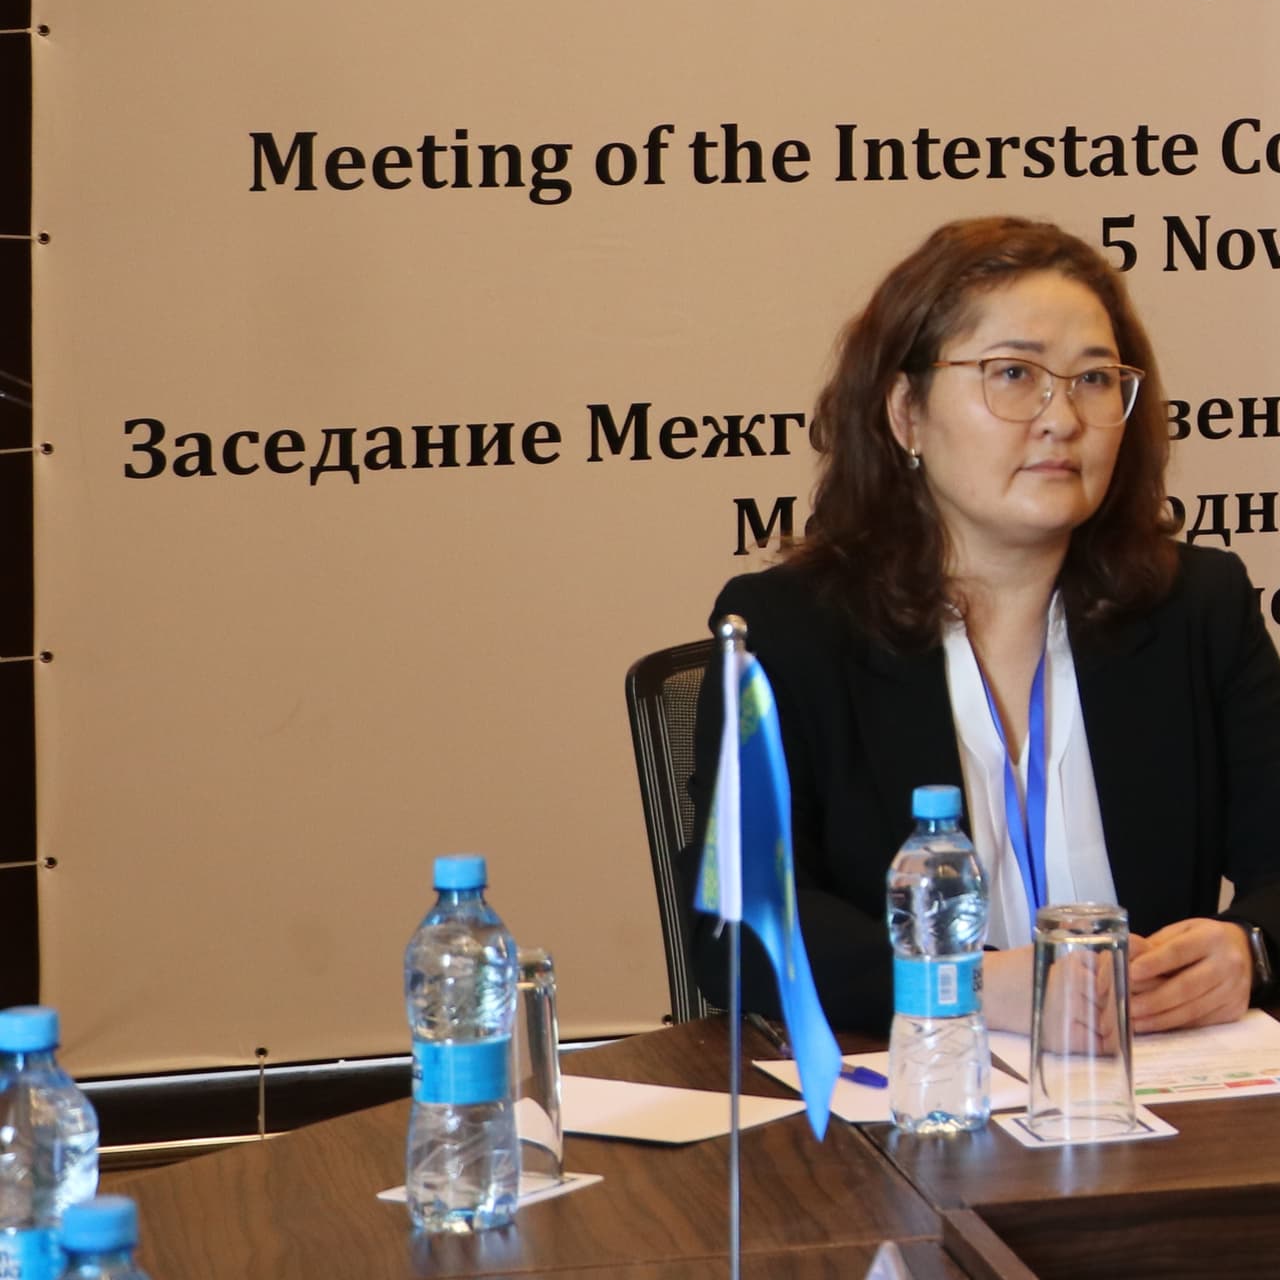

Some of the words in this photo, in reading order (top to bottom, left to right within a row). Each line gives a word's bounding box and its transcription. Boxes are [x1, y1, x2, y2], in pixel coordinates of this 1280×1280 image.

[248, 128, 573, 206] Meeting
[595, 123, 675, 187] of
[688, 123, 811, 185] the
[834, 124, 1199, 183] Interstate
[1102, 213, 1138, 273] 5
[124, 416, 562, 488] Заседание
